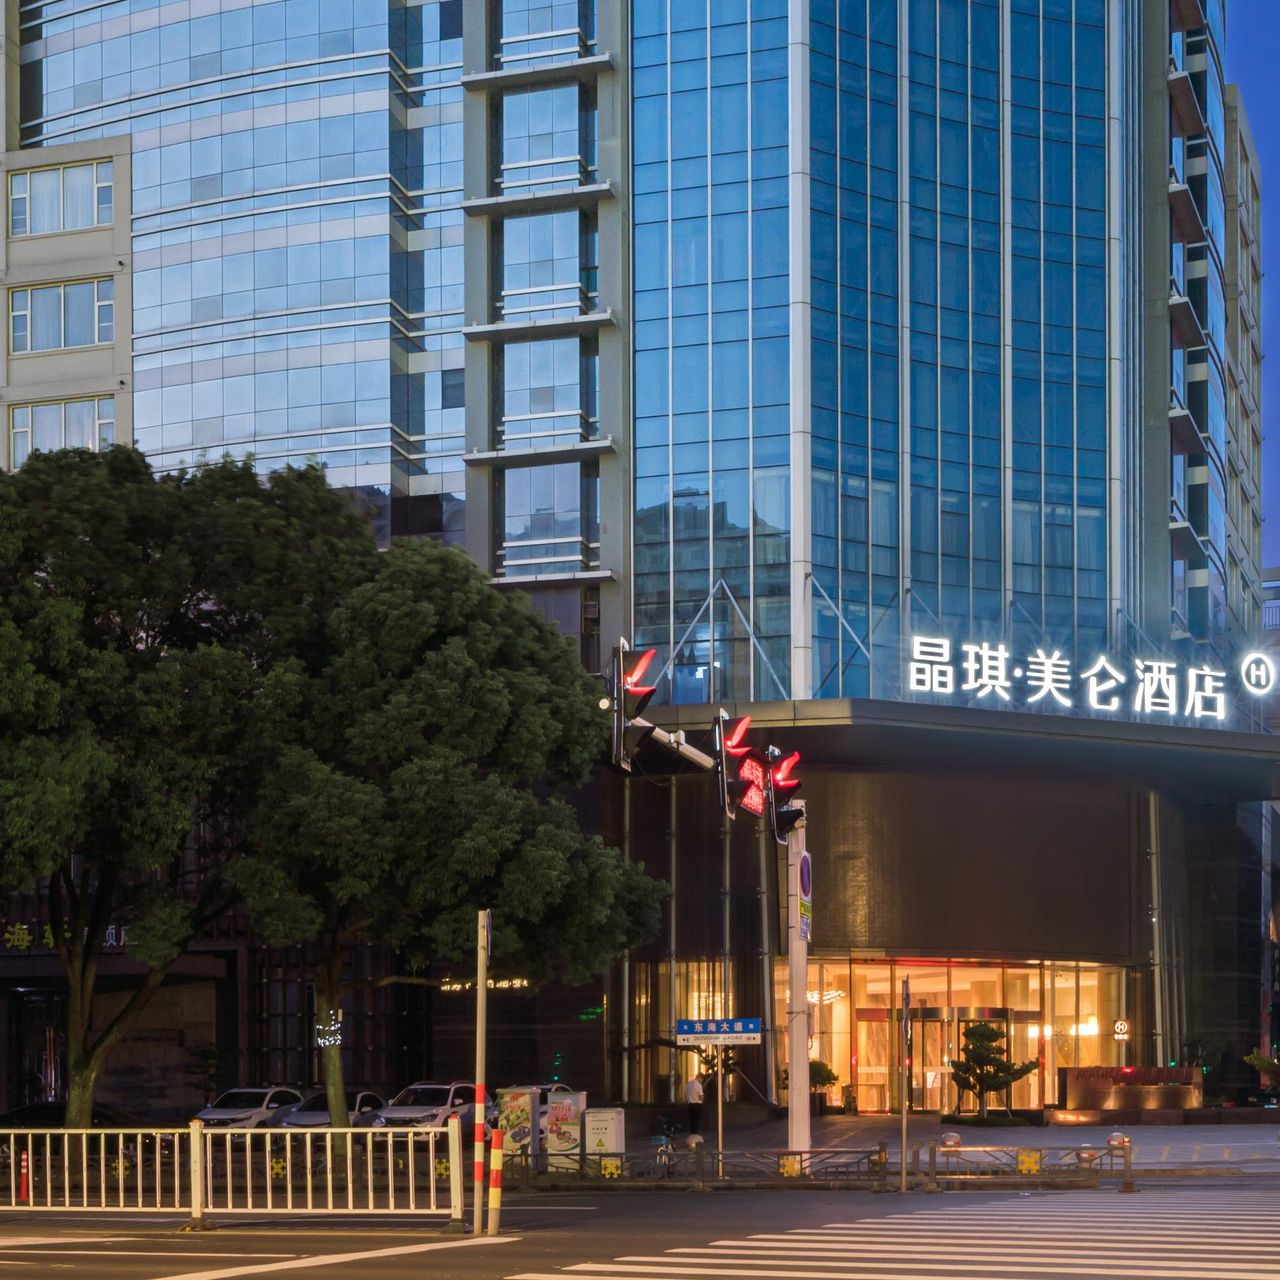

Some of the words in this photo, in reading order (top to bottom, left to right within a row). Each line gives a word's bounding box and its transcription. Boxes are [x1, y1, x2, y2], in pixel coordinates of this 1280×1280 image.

[909, 635, 1227, 720] 晶琪·美仑酒店
[694, 1021, 743, 1032] 东海大道
